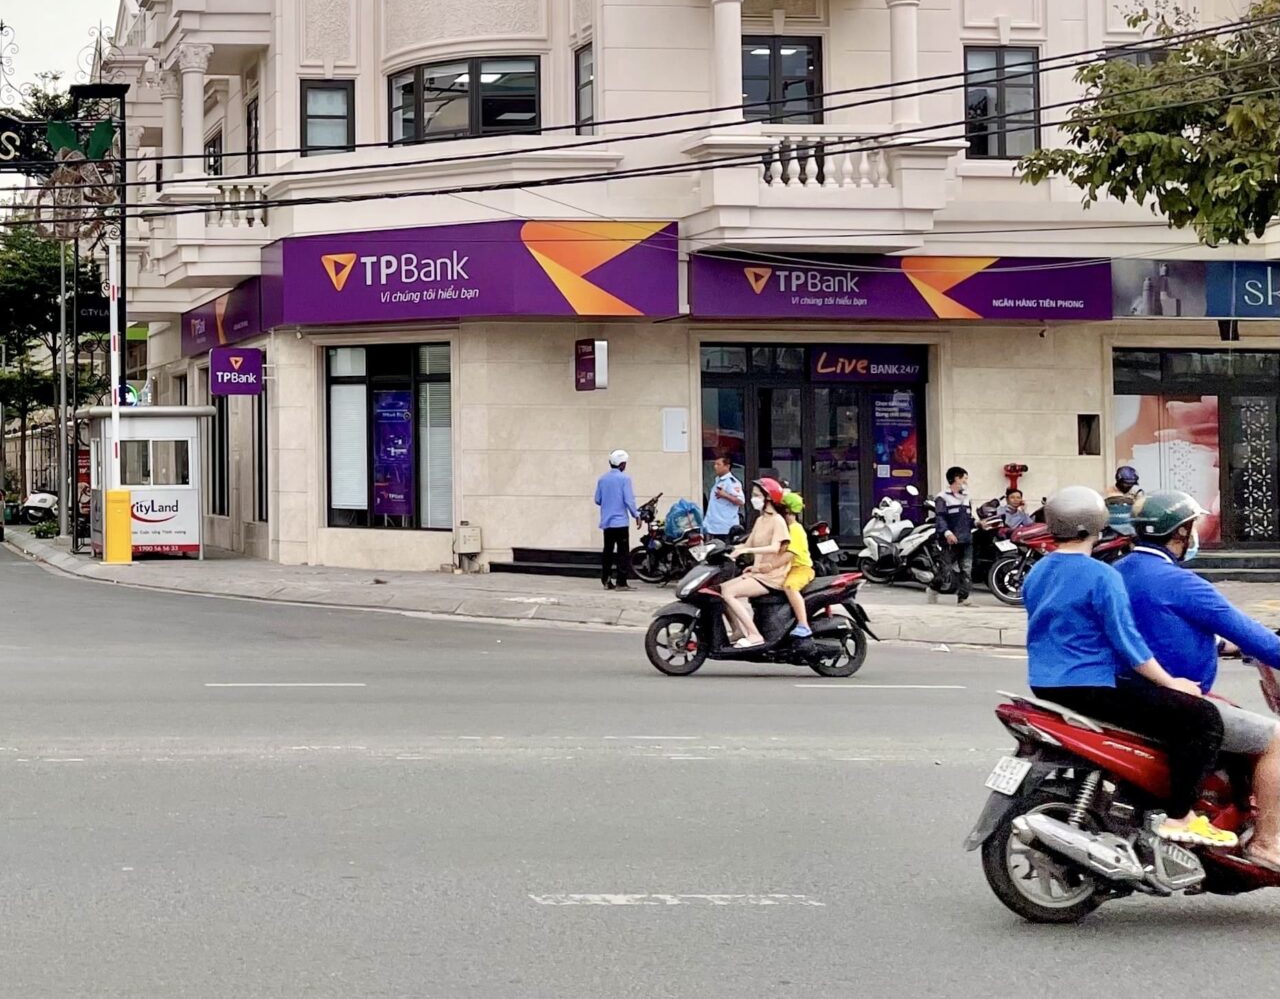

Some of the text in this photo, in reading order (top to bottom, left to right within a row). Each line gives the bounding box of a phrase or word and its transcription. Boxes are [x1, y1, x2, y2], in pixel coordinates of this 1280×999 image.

[360, 250, 469, 286] TPBank
[776, 271, 860, 293] TPBank
[392, 290, 420, 303] chúng
[423, 289, 435, 300] tôi
[437, 285, 458, 299] hiểu
[461, 287, 479, 300] bạn
[1057, 300, 1084, 308] PHONG
[80, 308, 110, 316] CITYLA
[870, 364, 899, 374] BANK
[899, 365, 920, 374] 24/7
[216, 372, 257, 384] TPBank
